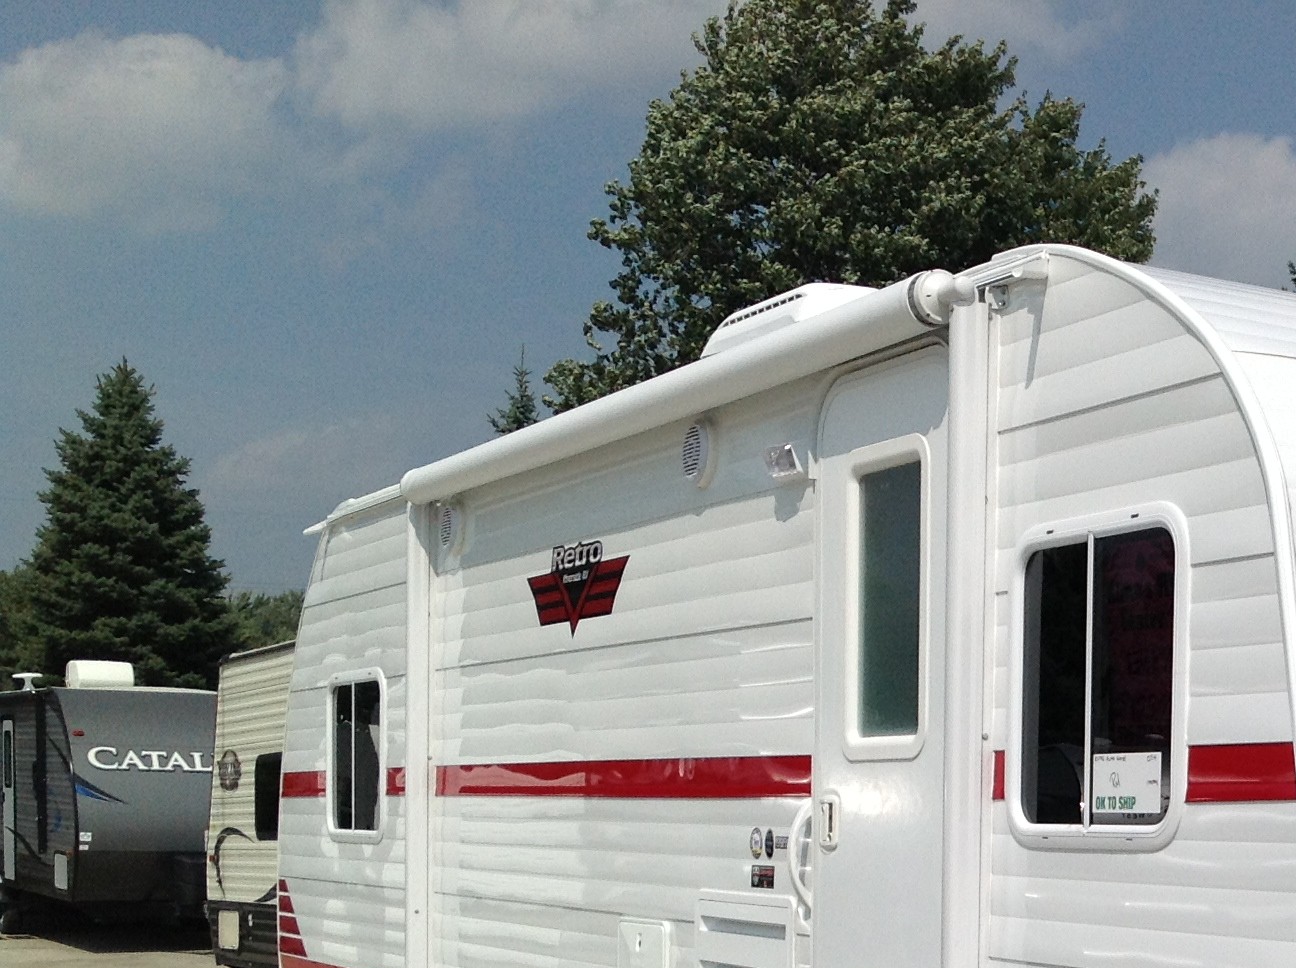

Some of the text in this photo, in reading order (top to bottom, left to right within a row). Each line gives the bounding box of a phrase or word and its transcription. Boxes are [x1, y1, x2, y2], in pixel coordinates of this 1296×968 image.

[552, 541, 602, 571] Retro
[87, 746, 214, 772] CATAL
[1095, 796, 1136, 810] OK TO SHIP
